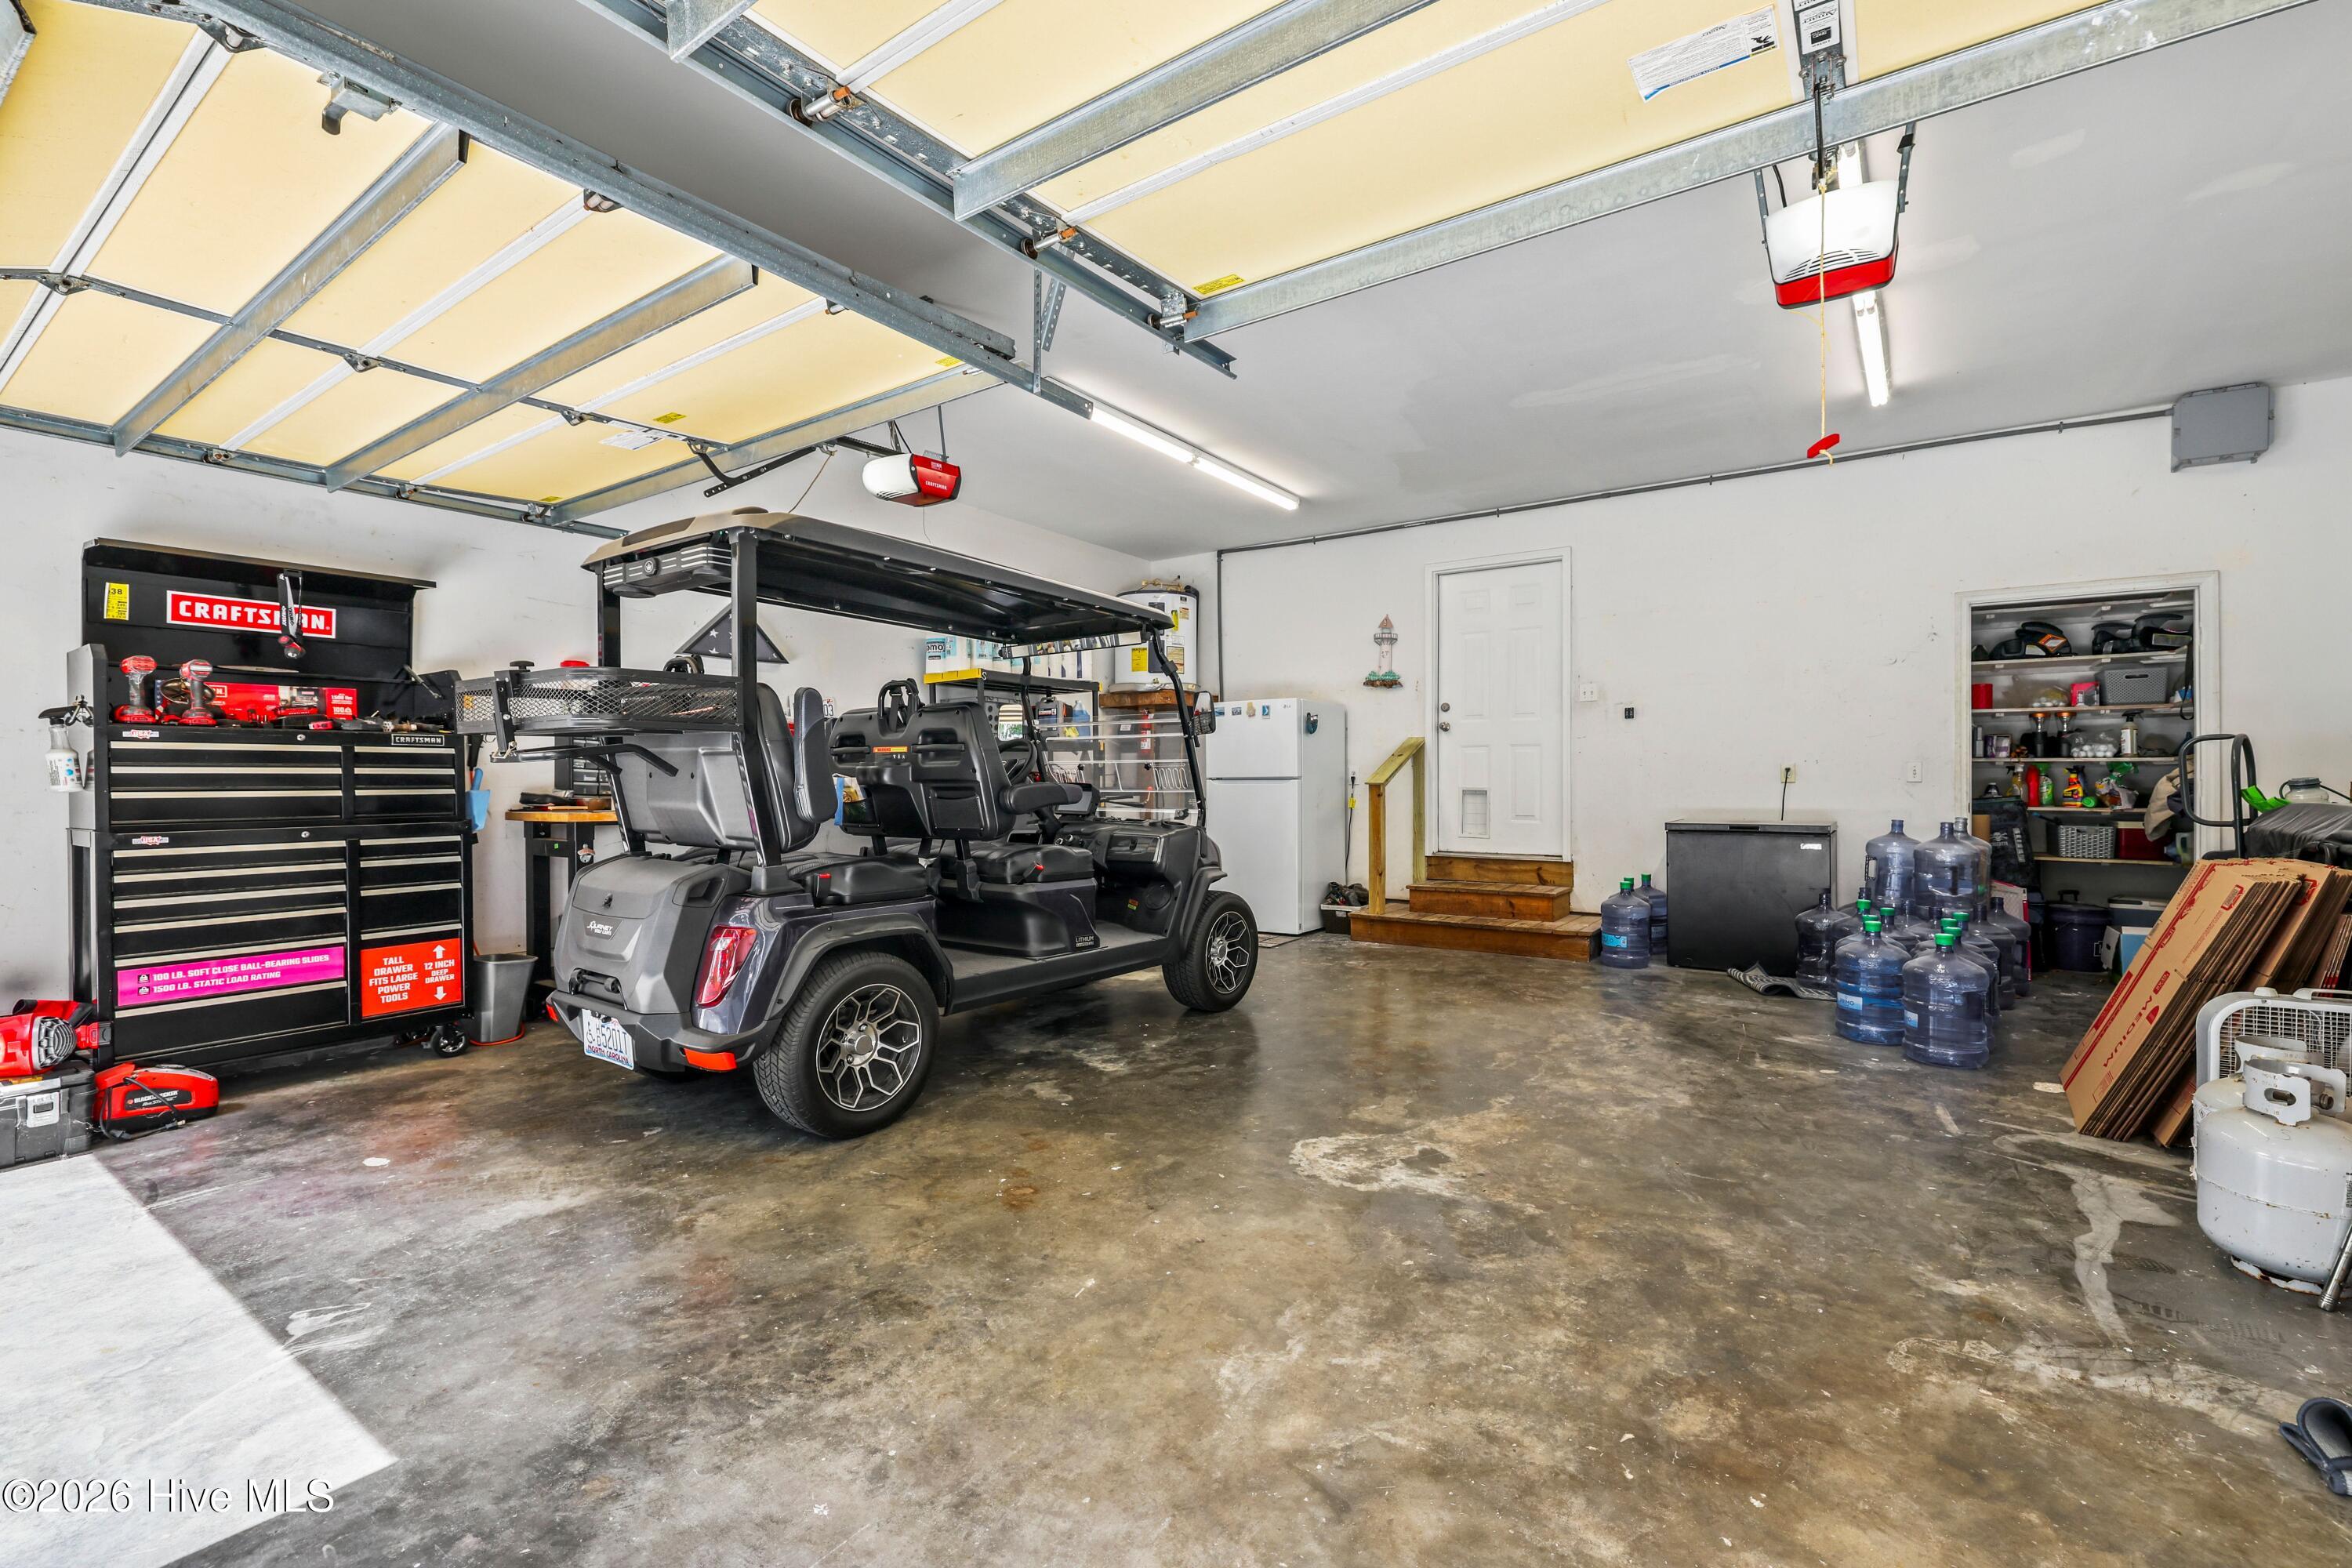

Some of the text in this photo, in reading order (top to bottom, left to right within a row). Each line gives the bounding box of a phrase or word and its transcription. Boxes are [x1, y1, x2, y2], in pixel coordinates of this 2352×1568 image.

[587, 920, 613, 931] JOURNEY
[383, 956, 405, 966] TALL
[423, 959, 455, 971] 12 INCH
[152, 954, 329, 982] 100 LB. SOFT CLOSE BALL-BEARING SLIDES
[374, 964, 413, 976] DRAWER
[431, 968, 448, 977] DEEP
[153, 971, 281, 993] 1500 LB. STATIC LOAD RATING
[368, 972, 419, 987] FITS LARGE
[425, 974, 455, 984] DRAWER
[377, 982, 411, 995] POWER
[380, 992, 408, 1004] TOOLS
[2103, 995, 2153, 1068] MEDIUM
[587, 1044, 630, 1064] NORTH CAROLINA
